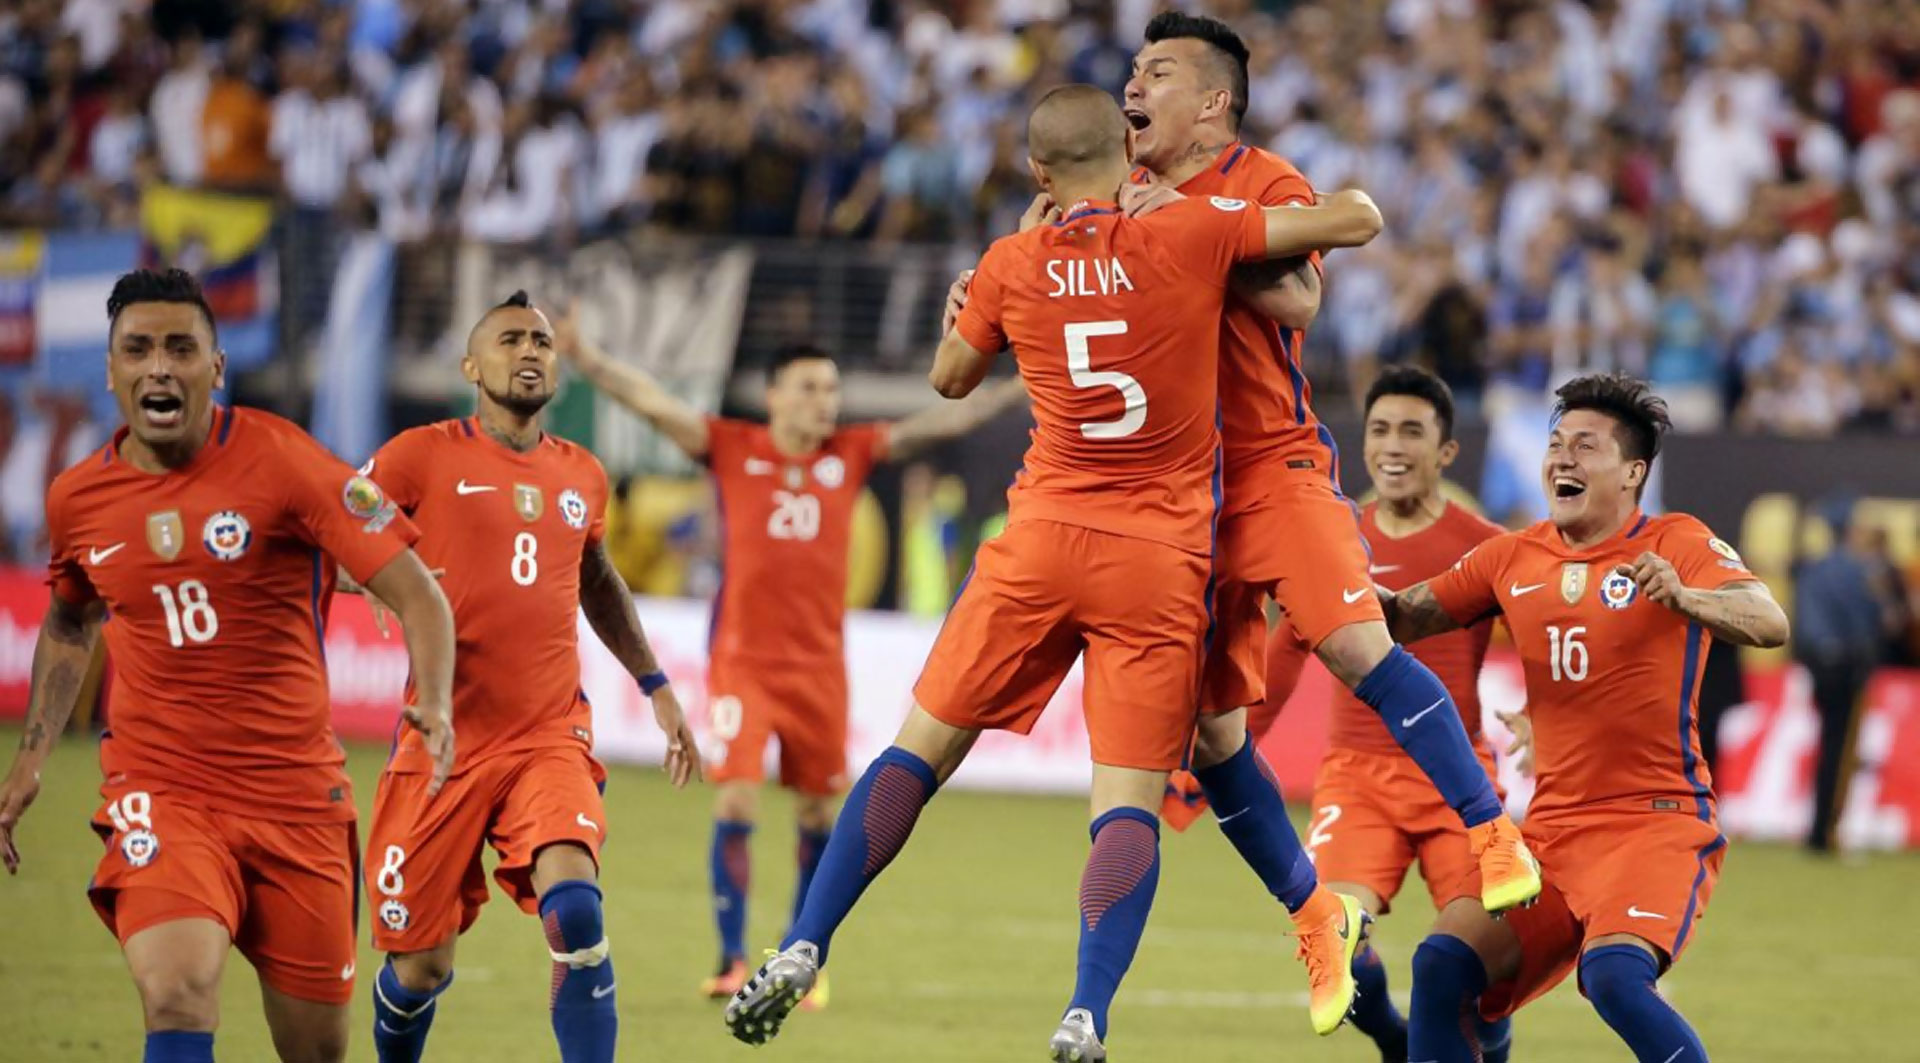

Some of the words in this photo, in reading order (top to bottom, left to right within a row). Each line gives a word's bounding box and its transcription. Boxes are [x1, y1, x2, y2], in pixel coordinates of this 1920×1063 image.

[1046, 257, 1134, 297] SILVA
[1064, 320, 1147, 438] 5
[767, 489, 821, 541] 20
[511, 532, 537, 586] 8
[152, 579, 218, 647] 18
[1546, 626, 1589, 682] 16
[377, 844, 405, 895] 8
